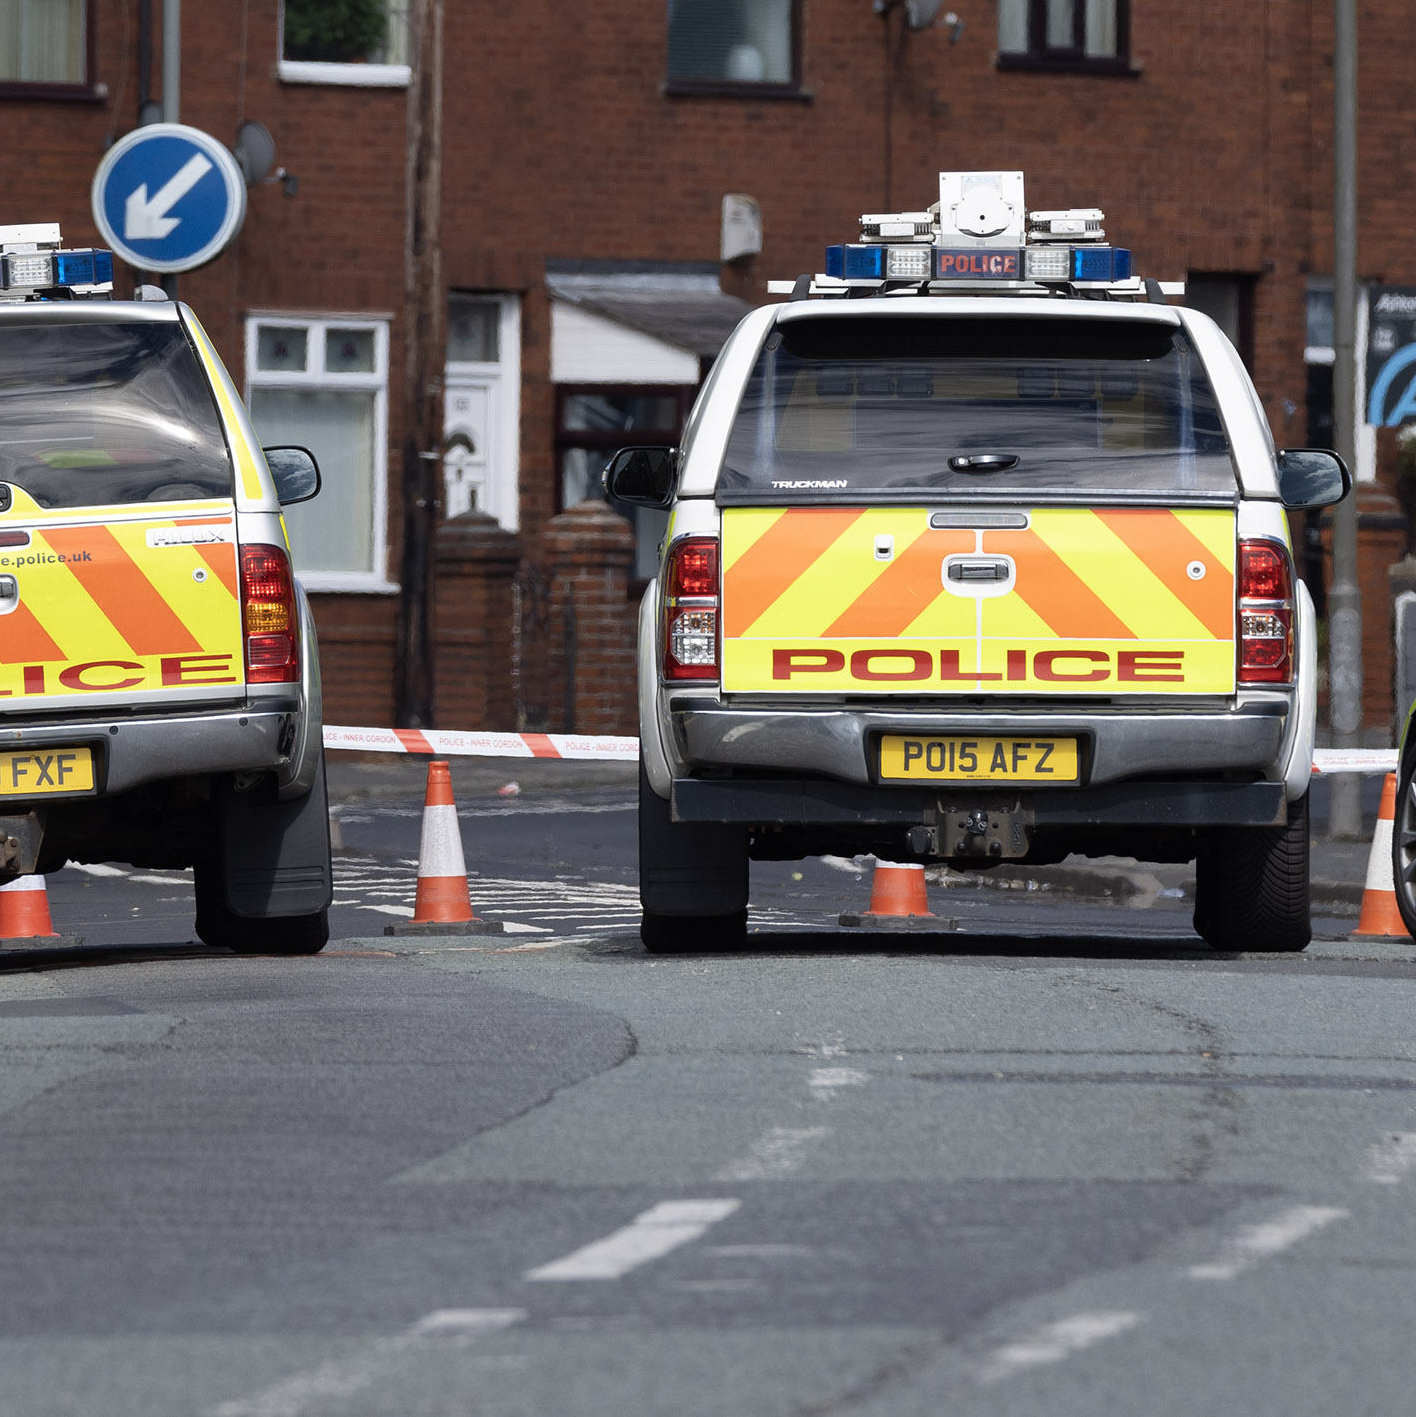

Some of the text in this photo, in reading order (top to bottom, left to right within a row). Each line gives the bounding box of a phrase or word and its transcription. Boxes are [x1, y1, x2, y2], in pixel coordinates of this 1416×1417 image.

[940, 254, 1016, 273] POLICE
[771, 479, 848, 489] TRUCKMAN
[153, 530, 225, 546] HILUX
[771, 648, 1186, 683] POLICE
[344, 733, 365, 743] INNER
[366, 734, 396, 744] CORDON
[439, 737, 465, 747] POLICE
[492, 739, 523, 749] CORDON
[565, 741, 591, 751] POLICE
[903, 740, 1056, 774] PO15 AFZ
[11, 754, 77, 788] FXF
